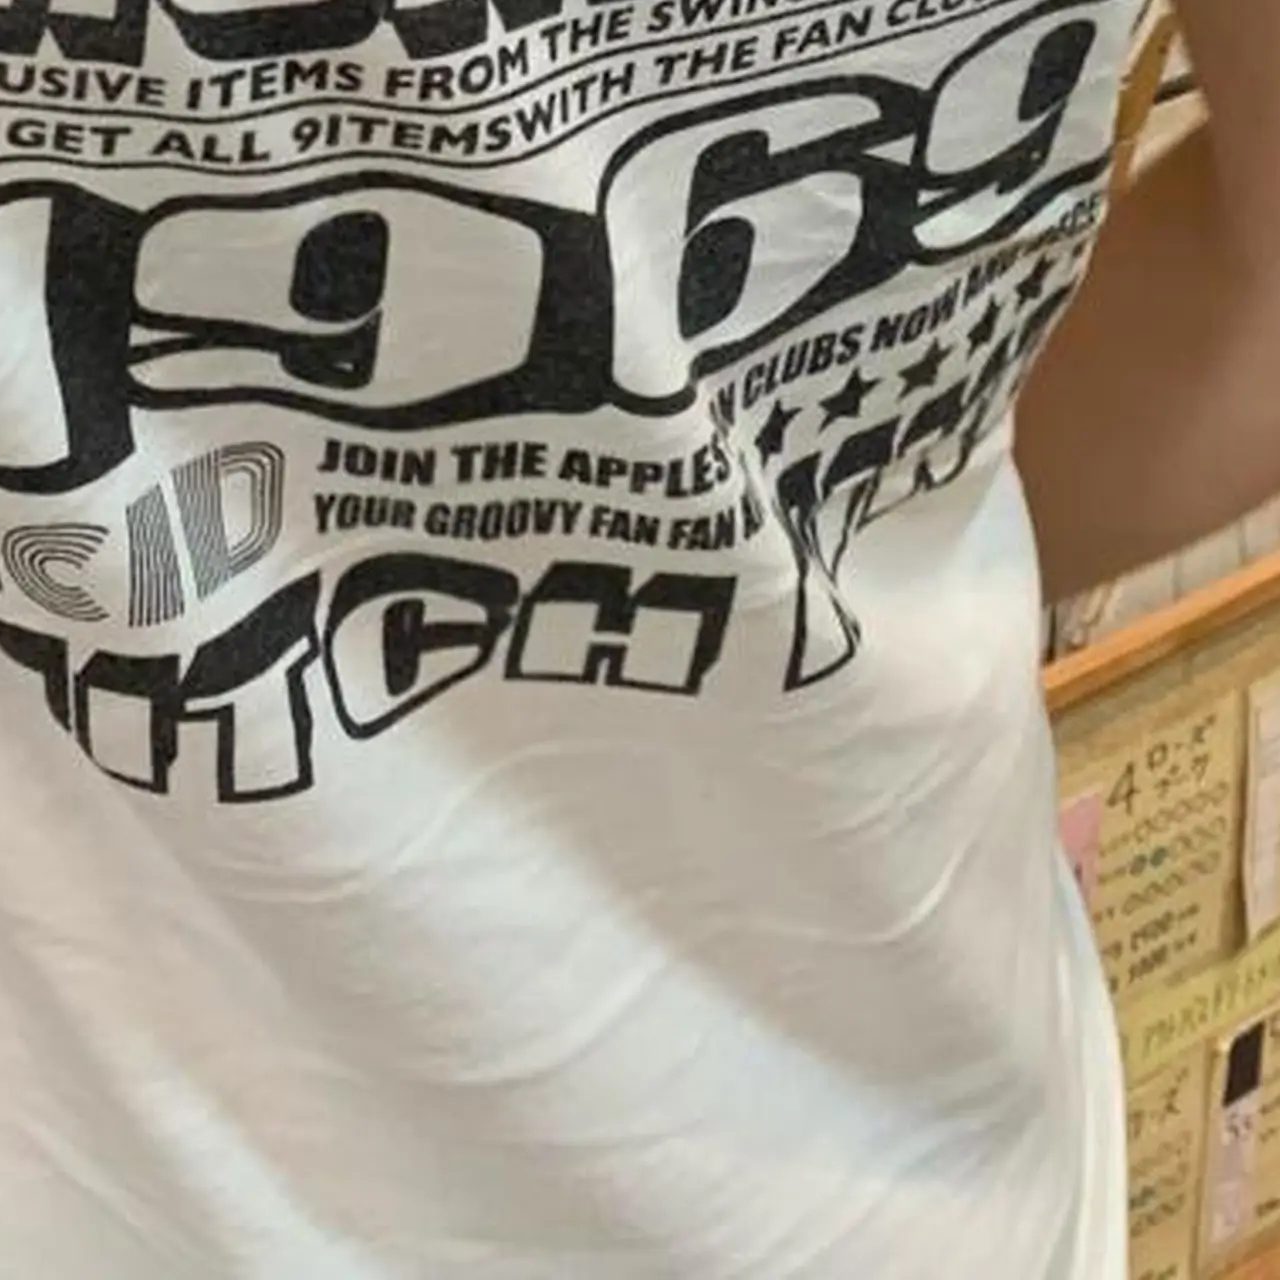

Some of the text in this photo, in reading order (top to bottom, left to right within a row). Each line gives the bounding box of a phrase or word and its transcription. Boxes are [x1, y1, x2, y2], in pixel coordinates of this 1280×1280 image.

[6, 118, 132, 157] GET
[149, 128, 271, 164] ALL
[654, 35, 760, 84] THE
[772, 6, 874, 61] FAN
[186, 58, 363, 110] ITEMS
[384, 38, 528, 102] FROM
[540, 4, 635, 62] THE
[742, 321, 866, 410] CLUBS
[869, 279, 963, 353] NOW
[317, 433, 731, 499] JOIN THE APPLES
[314, 492, 416, 534] YOUR
[423, 497, 584, 542] GROOVY
[588, 506, 659, 549] FAN
[666, 510, 735, 552] FAN
